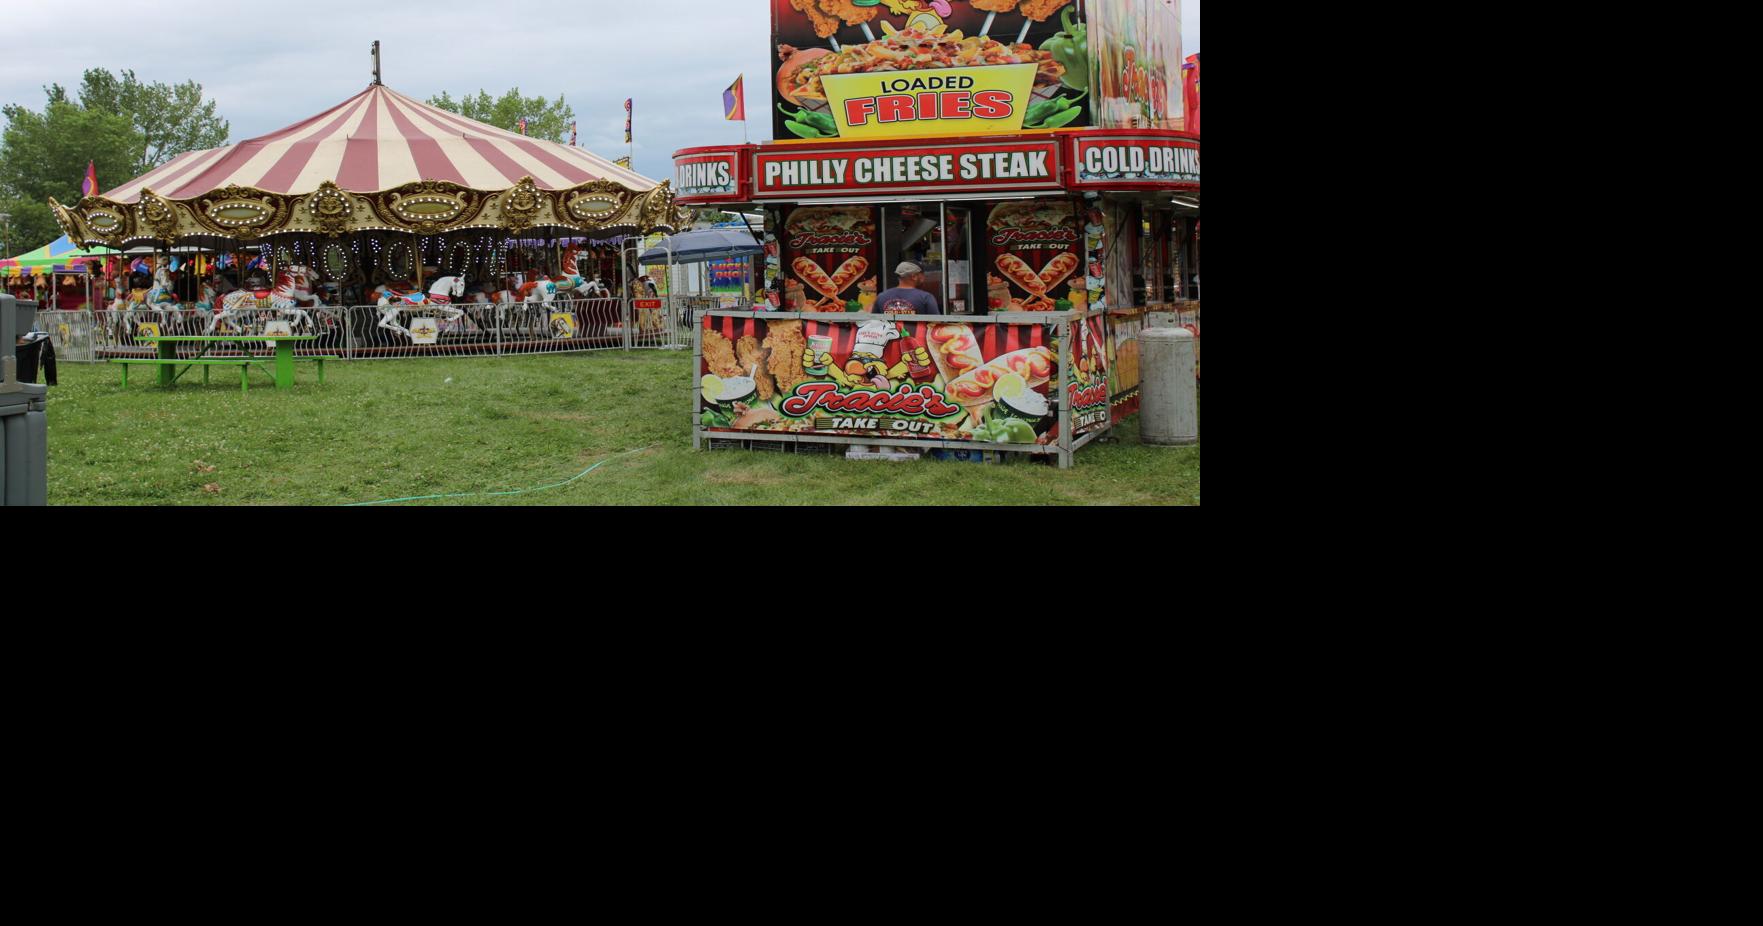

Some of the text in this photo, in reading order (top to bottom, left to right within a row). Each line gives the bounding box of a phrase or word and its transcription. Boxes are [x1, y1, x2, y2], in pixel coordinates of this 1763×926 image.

[881, 76, 974, 93] LOADED
[844, 90, 1013, 126] FRIES
[765, 151, 1049, 186] PHILLY CHEESE STEAK
[1085, 146, 1145, 173] COLD
[679, 161, 730, 187] DRINKS
[789, 230, 872, 248] Tracie's
[992, 226, 1079, 245] Tracie's
[783, 382, 960, 417] Tracie's
[831, 417, 935, 433] TAKE OUT
[1080, 412, 1096, 427] TAKE
